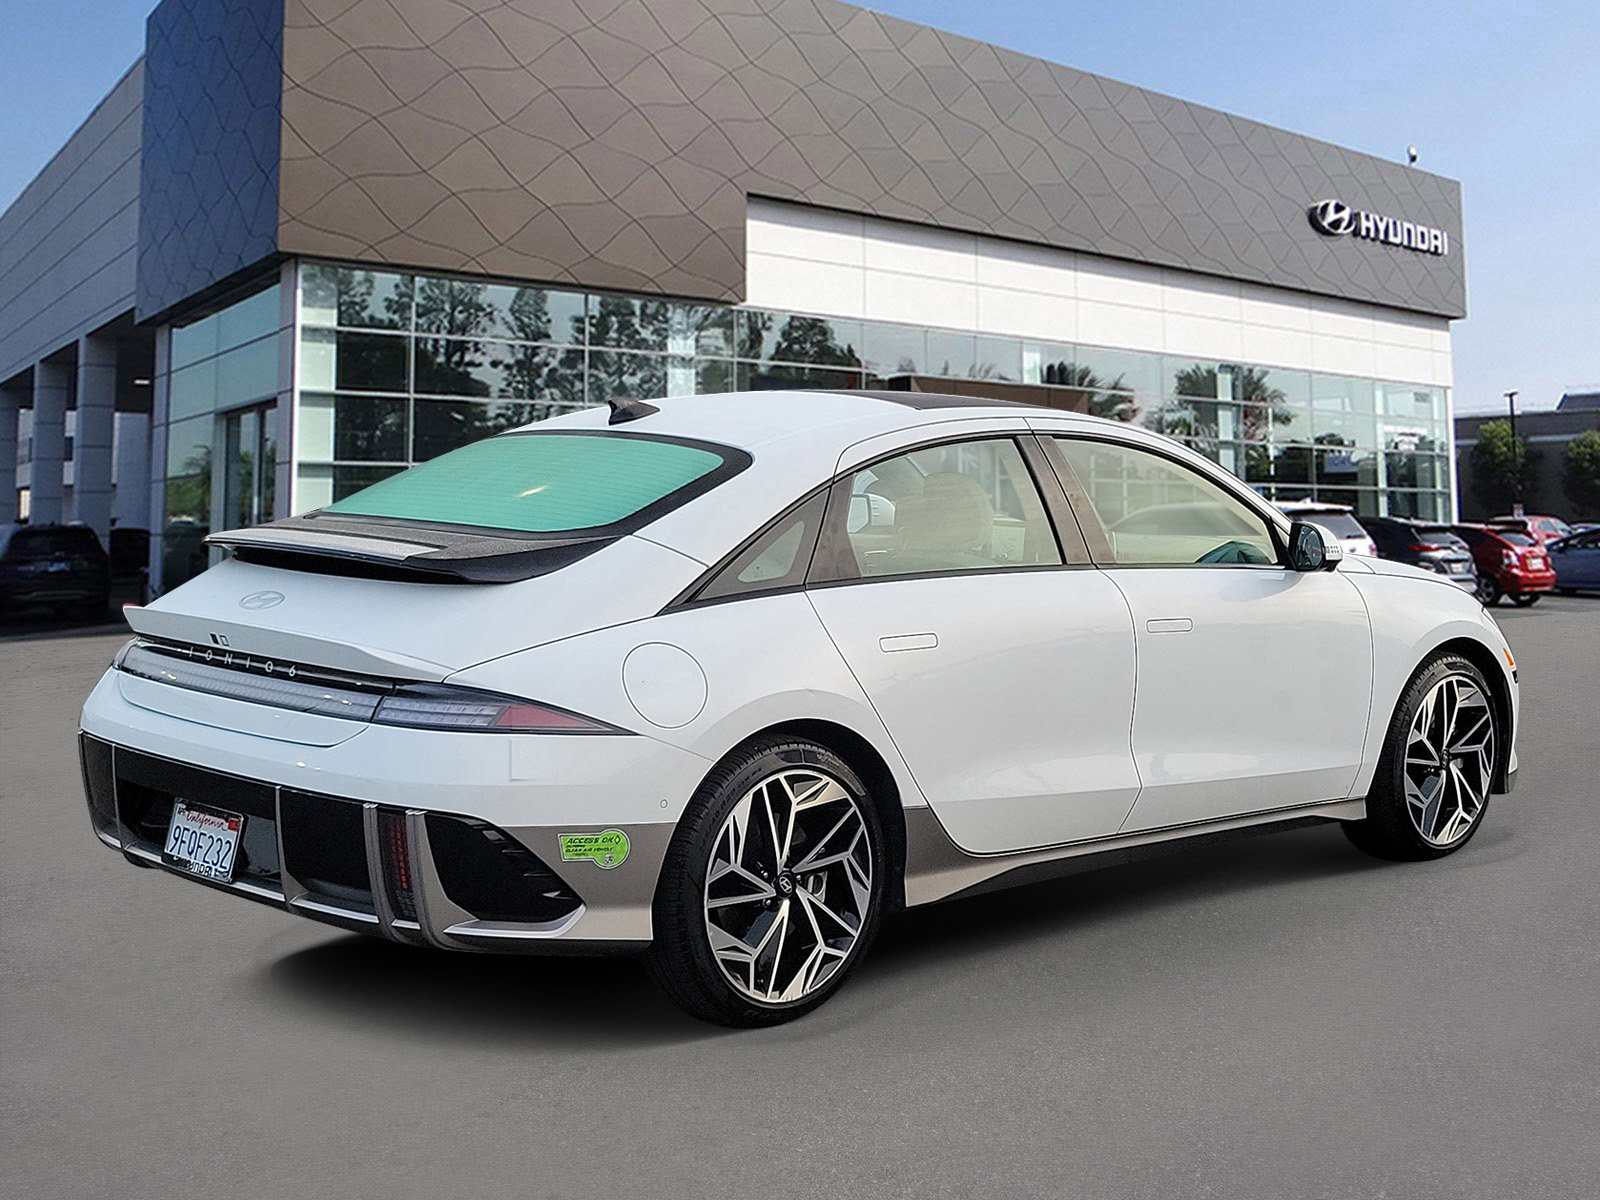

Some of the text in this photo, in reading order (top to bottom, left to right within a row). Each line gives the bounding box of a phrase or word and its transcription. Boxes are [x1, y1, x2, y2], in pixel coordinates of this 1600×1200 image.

[1359, 211, 1449, 255] HYUNDAI
[189, 646, 296, 677] IONIQ 6
[186, 811, 227, 831] California
